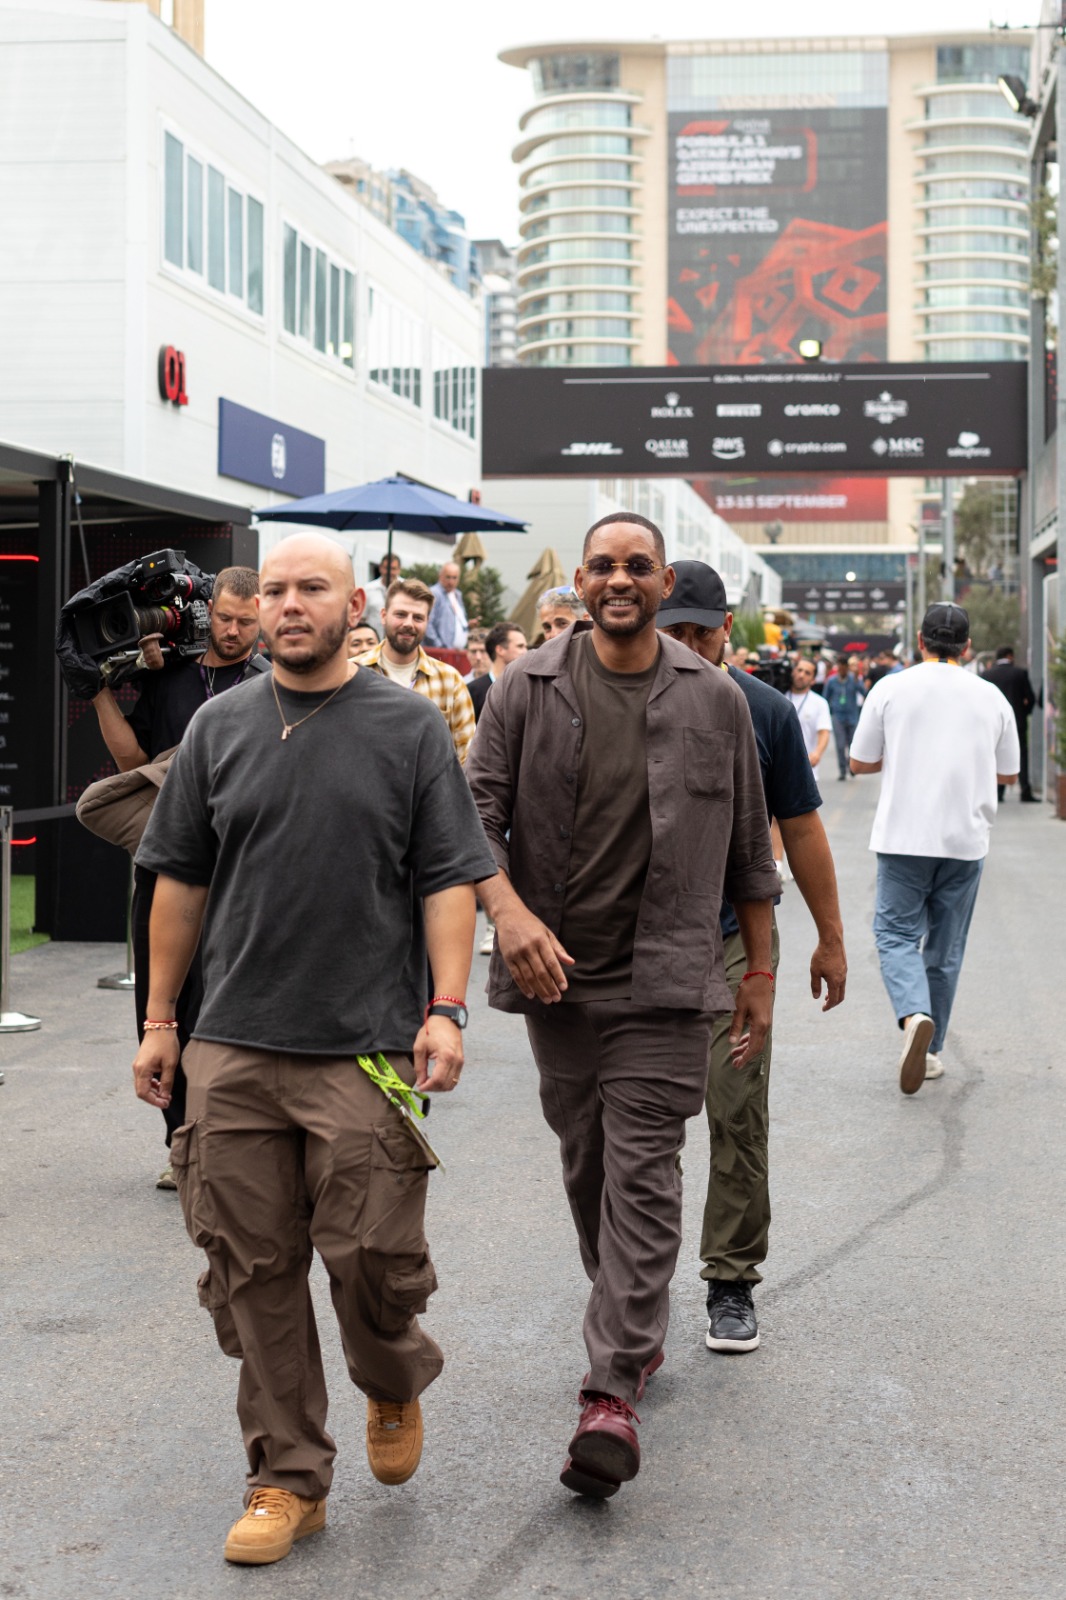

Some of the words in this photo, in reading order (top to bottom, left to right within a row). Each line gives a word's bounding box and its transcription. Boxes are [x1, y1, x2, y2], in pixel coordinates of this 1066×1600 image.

[676, 208, 734, 220] EXPECT
[738, 207, 769, 219] THE
[676, 220, 779, 233] UNEXPECTED
[650, 406, 694, 418] ROLEX
[784, 403, 841, 416] aramco
[645, 438, 689, 452] QATAR
[712, 437, 745, 451] aws
[784, 441, 847, 454] crypto.com
[889, 437, 924, 453] MSC
[756, 494, 848, 509] SEPTEMBER
